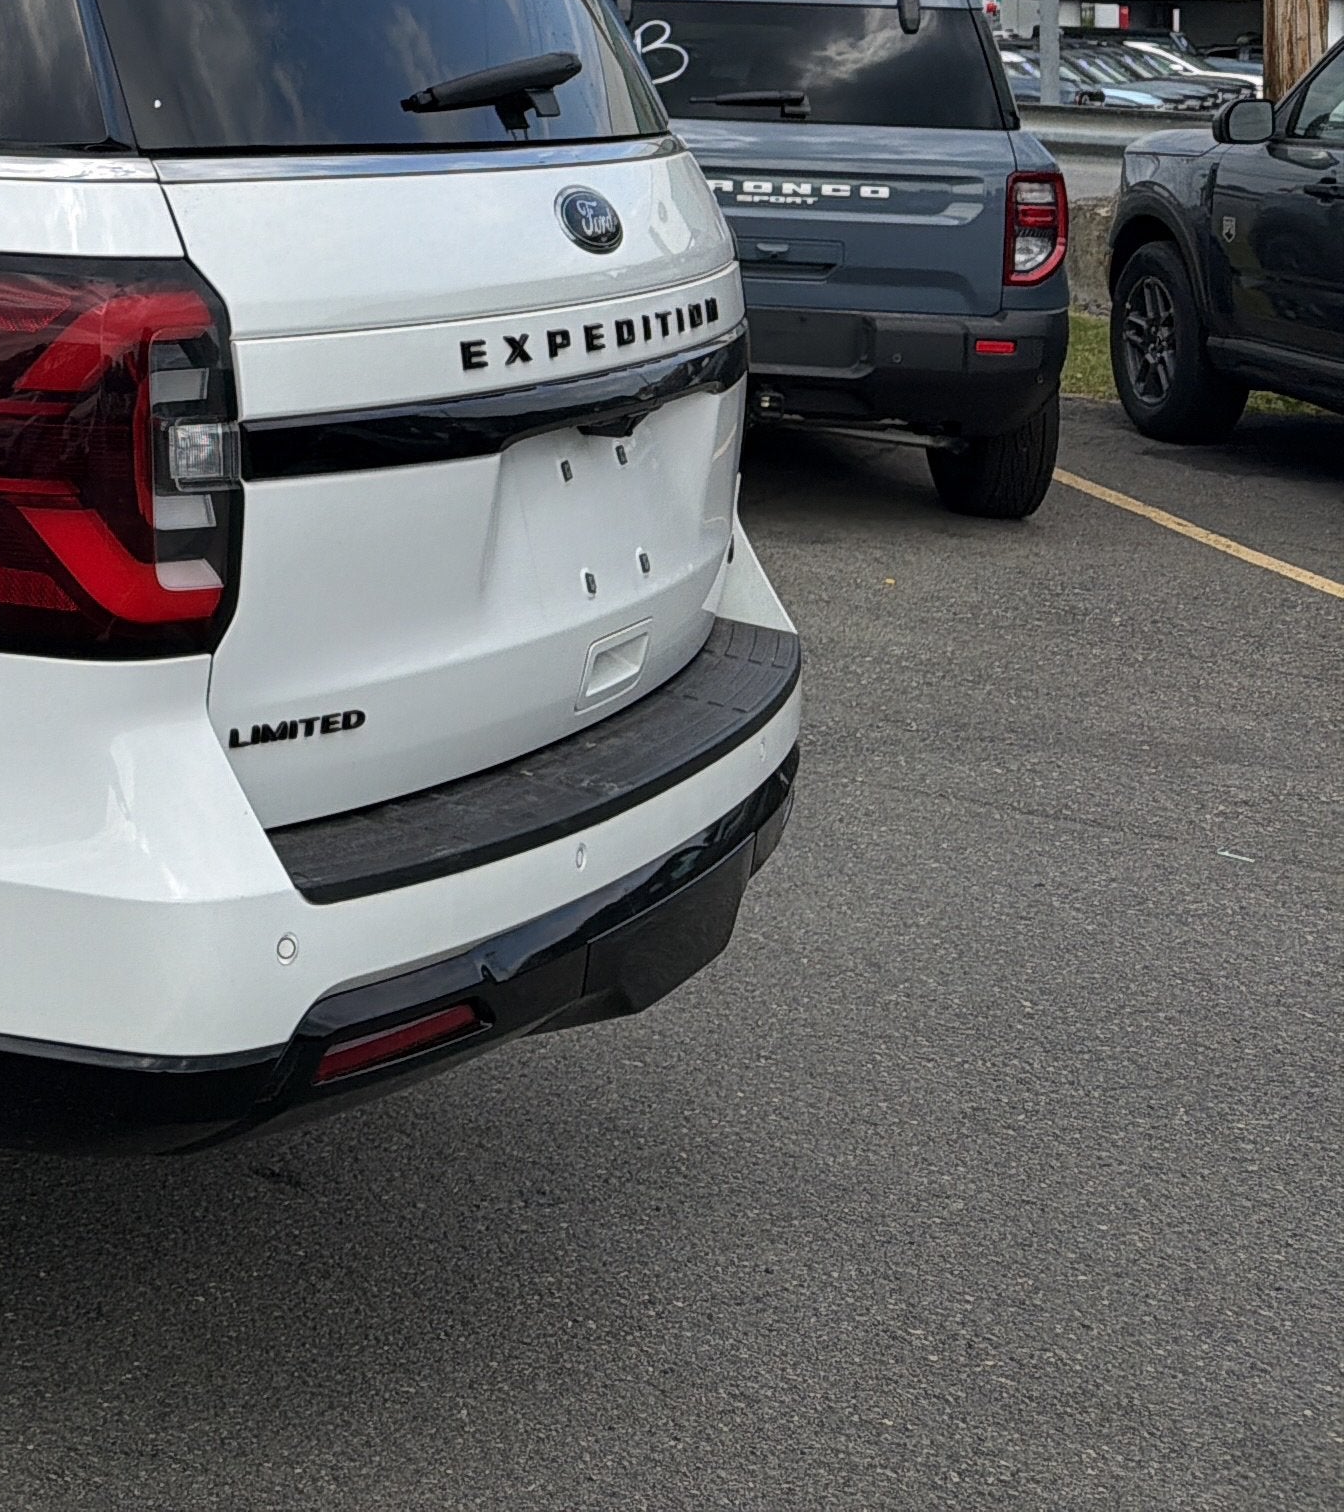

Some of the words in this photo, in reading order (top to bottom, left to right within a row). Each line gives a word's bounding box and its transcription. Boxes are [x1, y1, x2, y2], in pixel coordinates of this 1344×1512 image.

[705, 179, 890, 199] RONCO
[736, 193, 819, 205] SPORT
[576, 199, 619, 237] Ford
[459, 296, 719, 371] EXPEDITION
[228, 709, 367, 749] LIMITED
